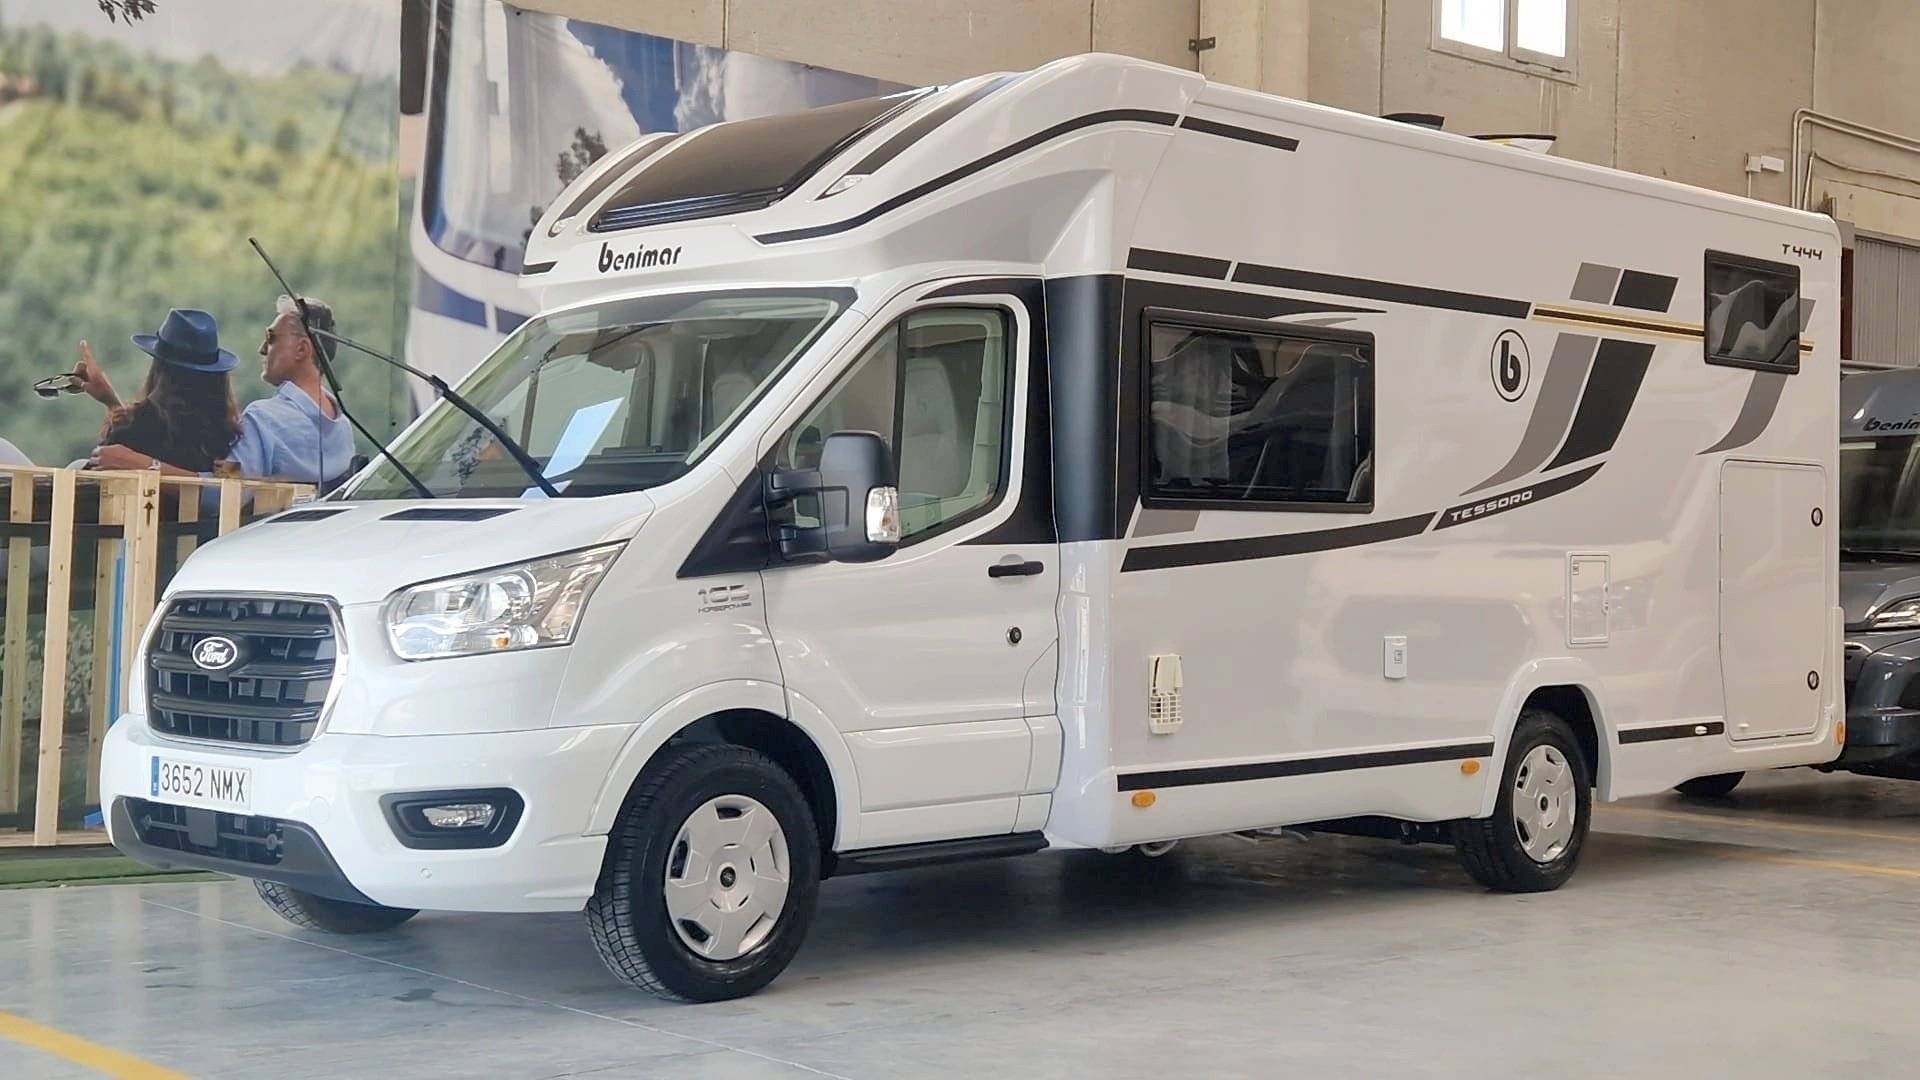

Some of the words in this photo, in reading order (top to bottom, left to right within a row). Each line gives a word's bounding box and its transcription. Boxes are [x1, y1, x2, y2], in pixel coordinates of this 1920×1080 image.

[598, 241, 682, 273] benimar
[1782, 243, 1791, 254] T
[1792, 245, 1823, 260] 444
[1450, 490, 1533, 521] TESSORO
[698, 584, 750, 604] 105
[199, 641, 228, 663] Ford
[161, 763, 203, 797] 3652
[210, 768, 246, 803] NMX
